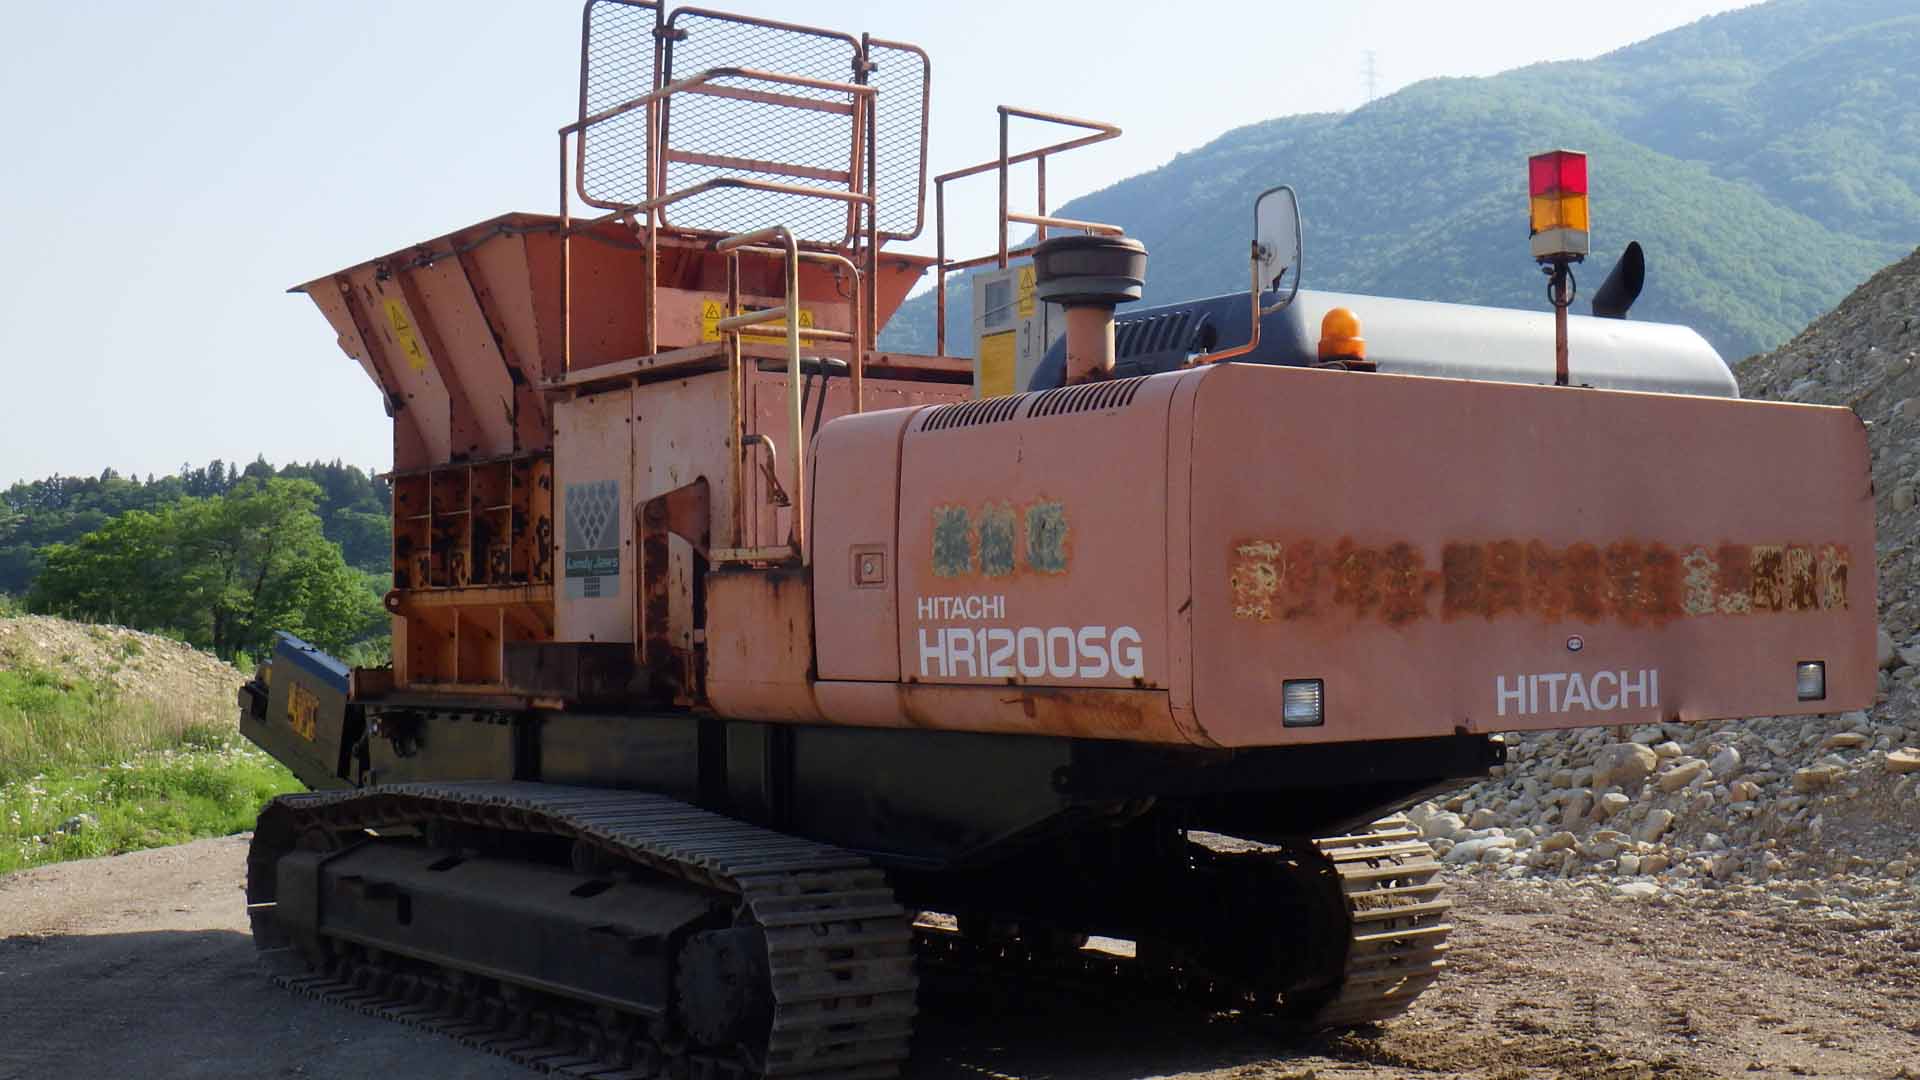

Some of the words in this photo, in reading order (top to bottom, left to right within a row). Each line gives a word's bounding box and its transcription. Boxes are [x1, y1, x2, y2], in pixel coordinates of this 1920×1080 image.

[917, 595, 1006, 619] HITACHI
[919, 626, 1144, 678] HR1200SG
[1497, 669, 1659, 716] HITACHI
